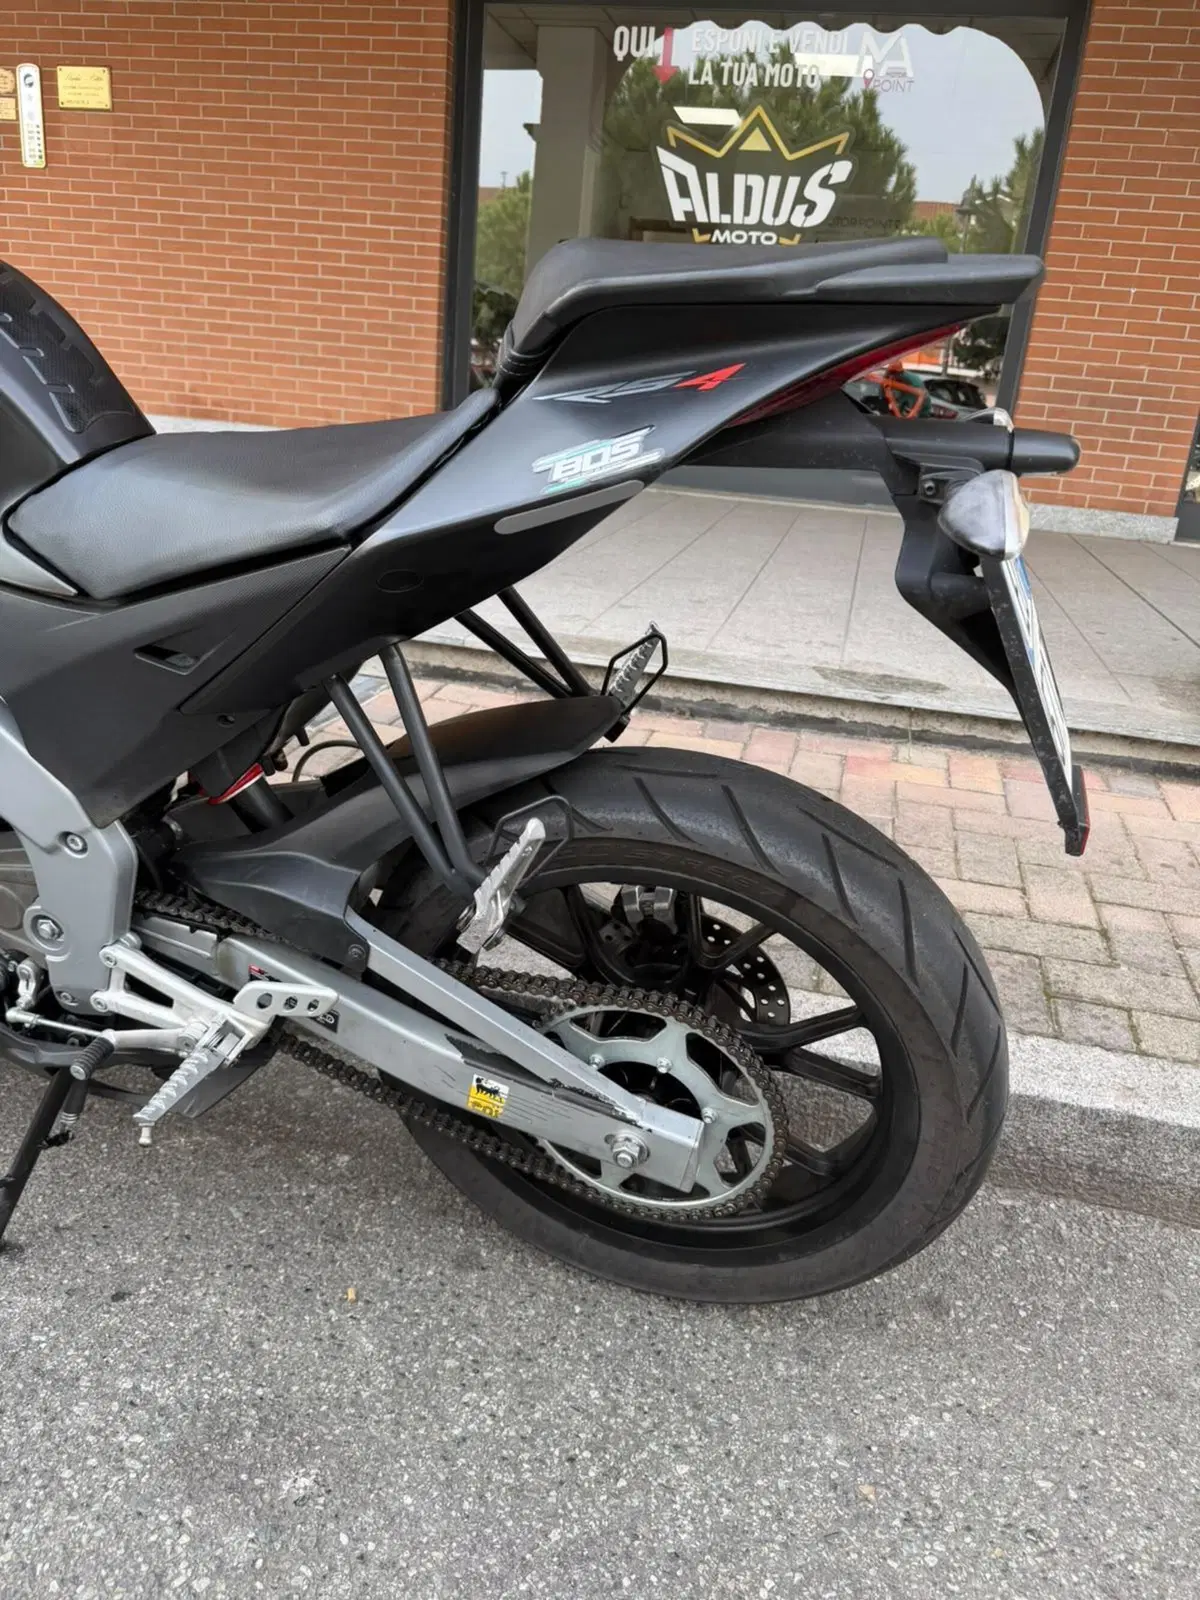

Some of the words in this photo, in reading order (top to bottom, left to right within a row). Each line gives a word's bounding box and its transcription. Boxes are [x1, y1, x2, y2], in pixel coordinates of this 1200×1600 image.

[613, 25, 656, 62] QUI
[691, 29, 762, 53] ESPONI
[768, 30, 781, 53] E
[789, 30, 848, 54] VENDI
[688, 60, 714, 86] LA
[720, 60, 758, 87] TUA
[763, 62, 820, 89] MOTO
[872, 79, 915, 92] POINT
[656, 146, 853, 228] ALDUS
[711, 229, 777, 245] MOTO
